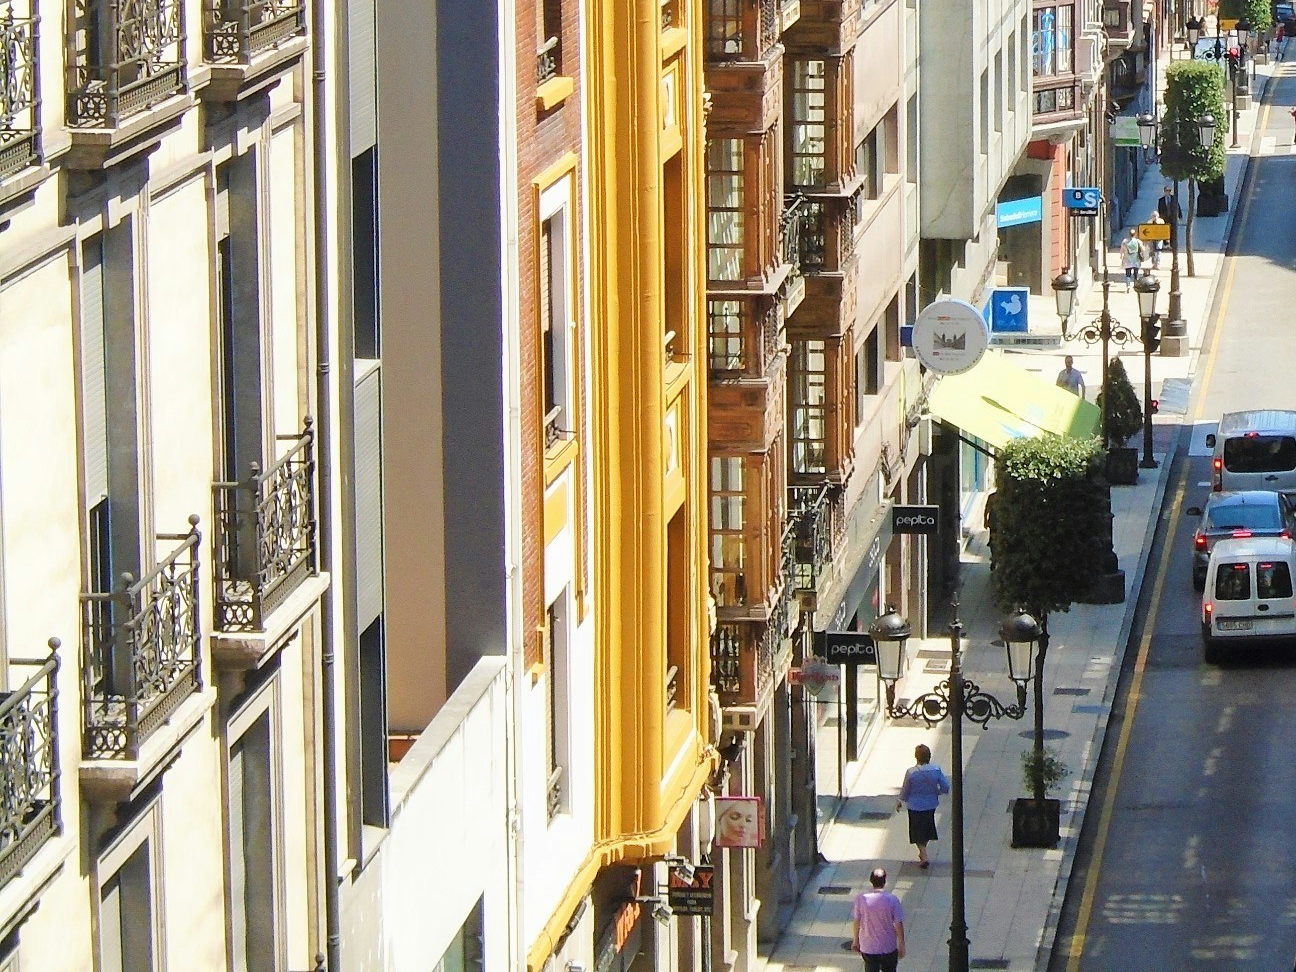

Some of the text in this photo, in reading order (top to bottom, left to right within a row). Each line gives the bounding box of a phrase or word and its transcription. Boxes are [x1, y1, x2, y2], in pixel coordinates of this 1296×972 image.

[1084, 191, 1097, 208] S
[896, 515, 935, 527] pepita
[831, 643, 874, 656] pepita
